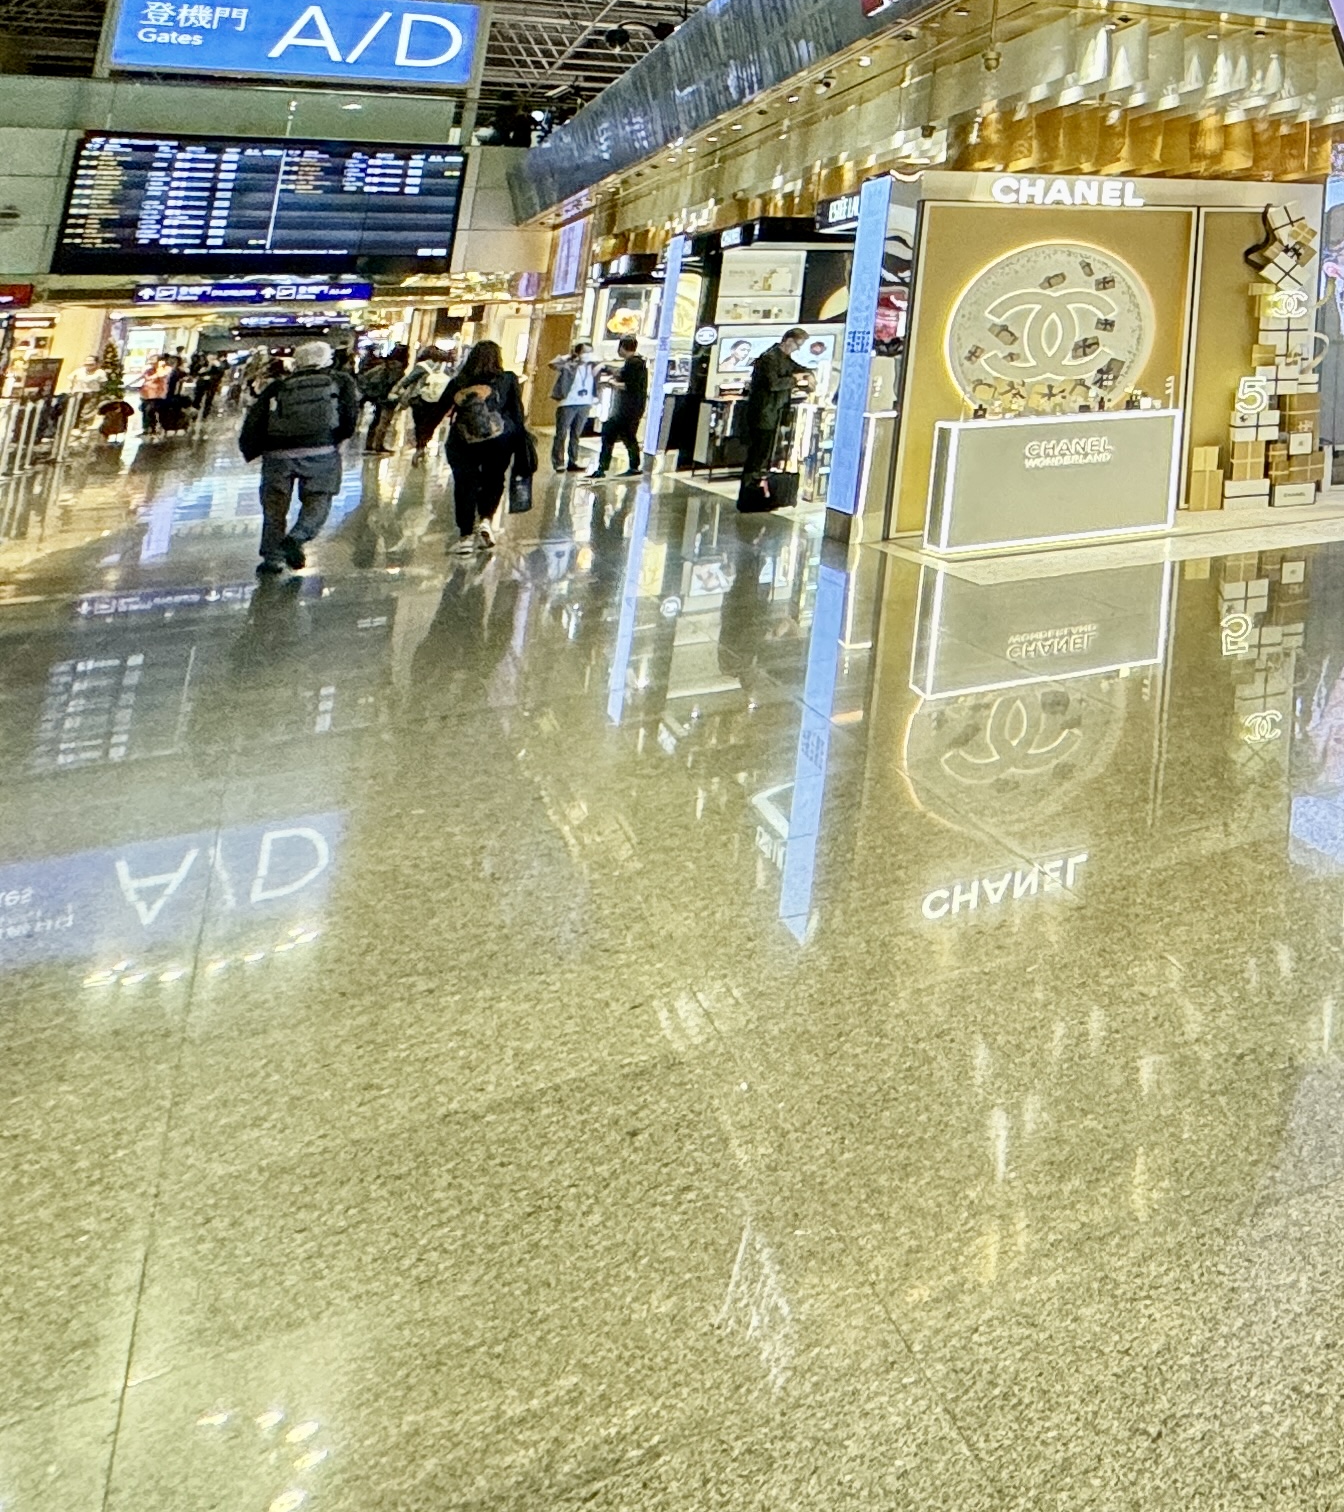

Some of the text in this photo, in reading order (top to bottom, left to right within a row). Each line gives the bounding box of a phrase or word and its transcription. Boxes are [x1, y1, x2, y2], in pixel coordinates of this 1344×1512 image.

[139, 0, 249, 32] 登機門
[137, 27, 204, 47] Gates
[267, 5, 463, 67] A/D
[992, 176, 1145, 207] CHANEL
[1235, 375, 1269, 414] 5
[1024, 436, 1115, 458] CHANEL
[1024, 451, 1112, 468] WONDERLAND
